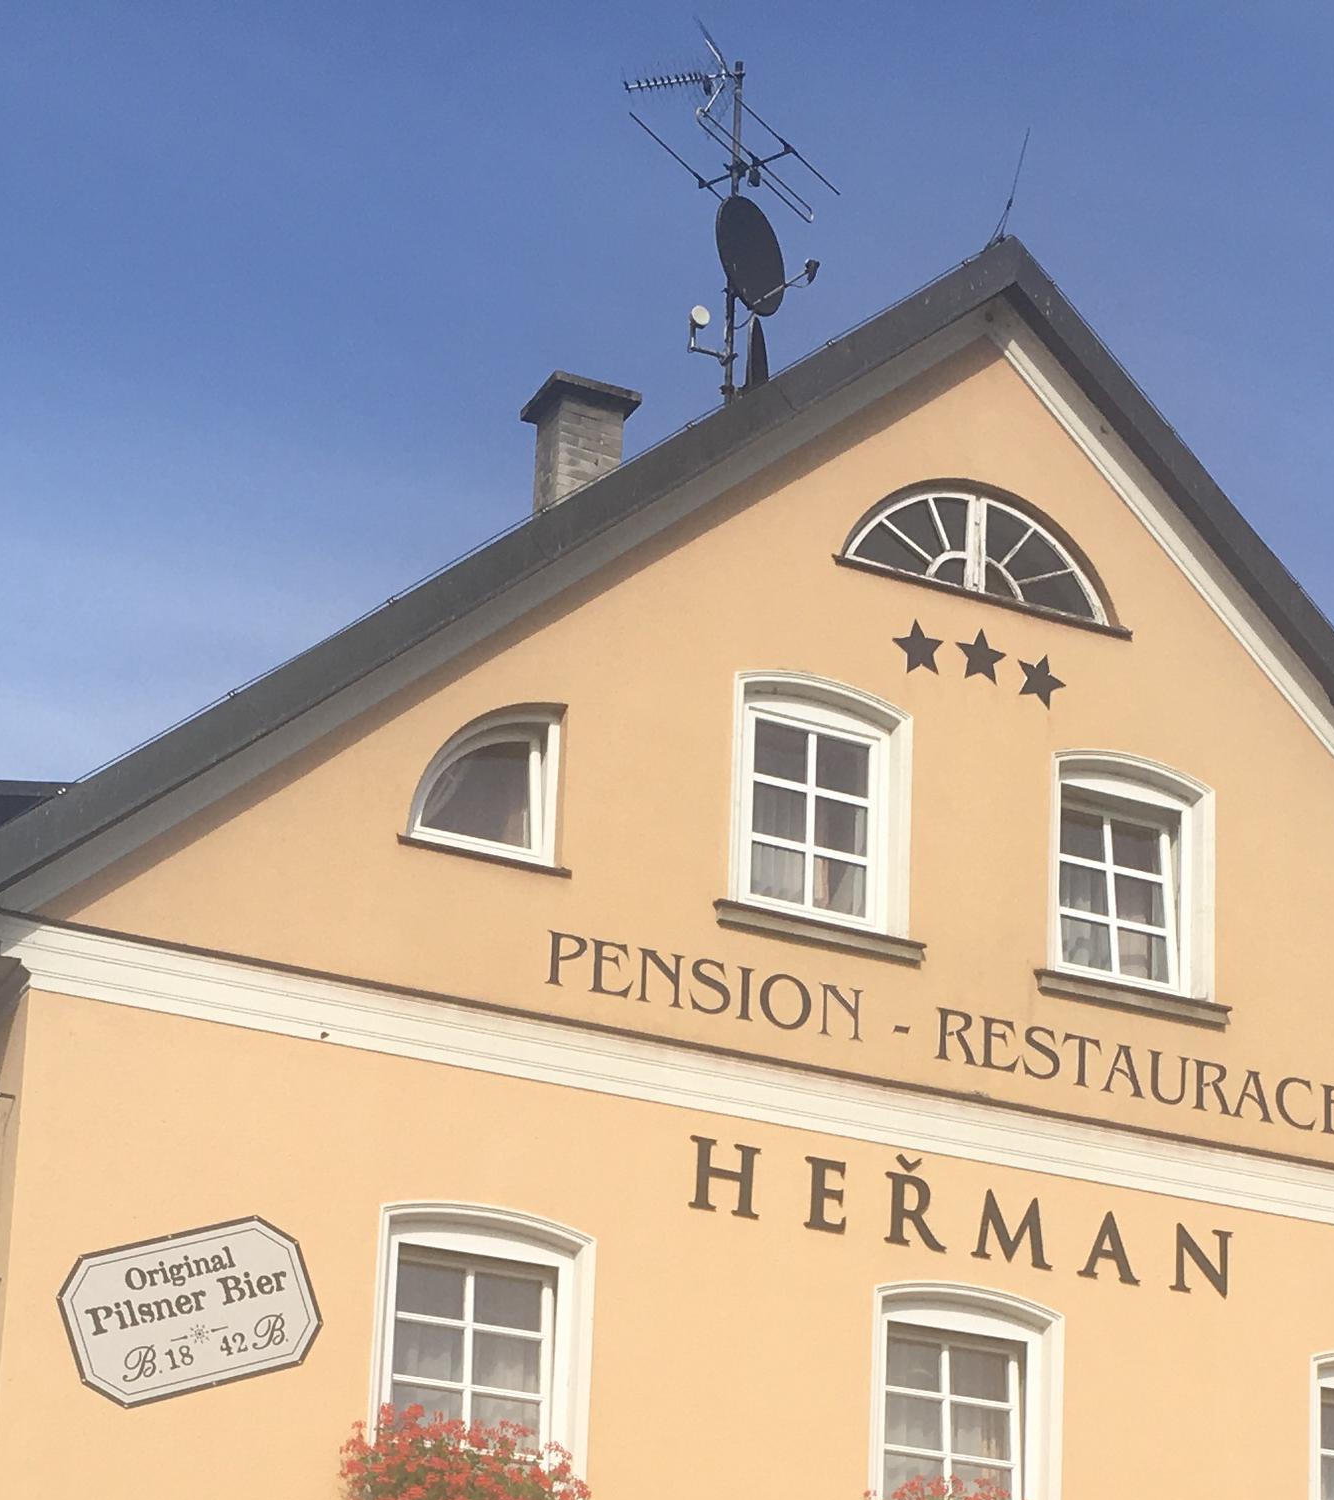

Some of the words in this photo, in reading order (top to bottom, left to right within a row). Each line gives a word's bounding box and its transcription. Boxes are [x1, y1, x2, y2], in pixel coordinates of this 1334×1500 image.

[545, 930, 864, 1042] PENSION
[689, 1135, 1233, 1298] HEŘMAN
[125, 1246, 237, 1292] Original
[84, 1288, 207, 1336] Pilsner
[216, 1270, 288, 1306] Bier
[165, 1345, 195, 1371] 18
[220, 1332, 249, 1357] 42
